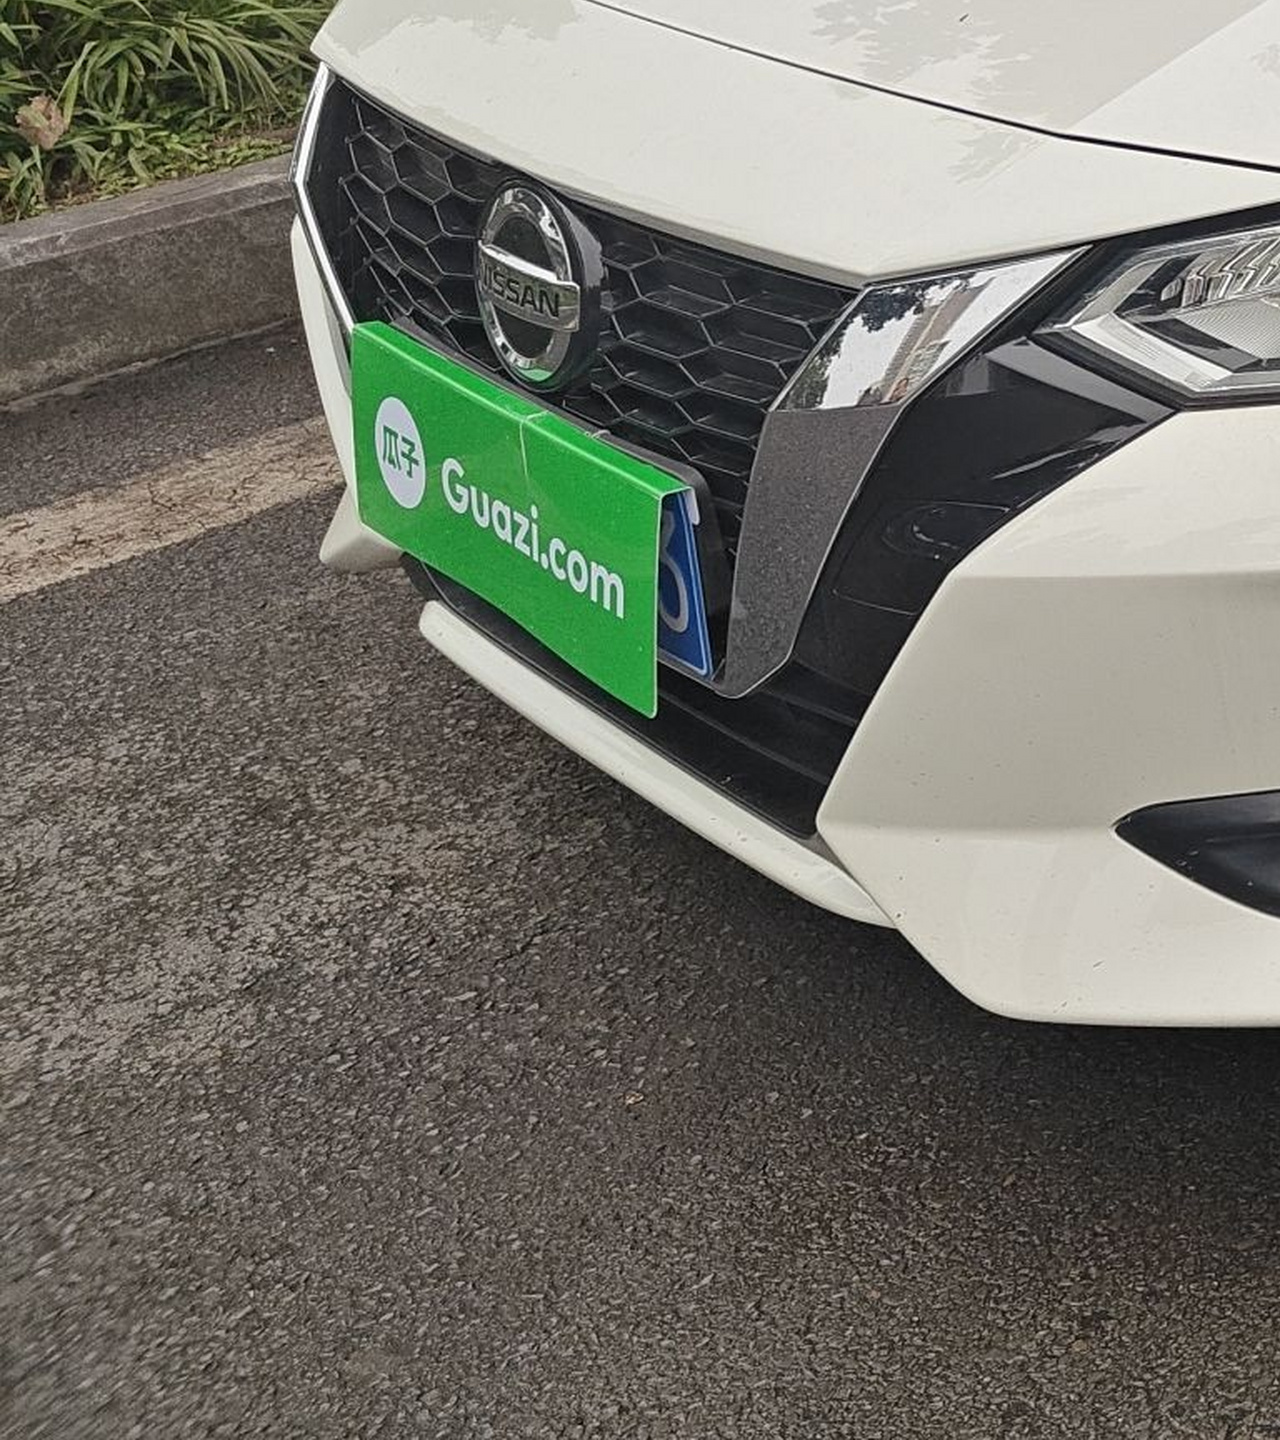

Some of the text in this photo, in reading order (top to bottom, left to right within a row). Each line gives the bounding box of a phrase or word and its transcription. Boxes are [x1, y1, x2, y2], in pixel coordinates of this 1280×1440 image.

[480, 261, 561, 318] NISSAN
[381, 424, 421, 480] 瓜子
[441, 456, 626, 620] Guazi.com
